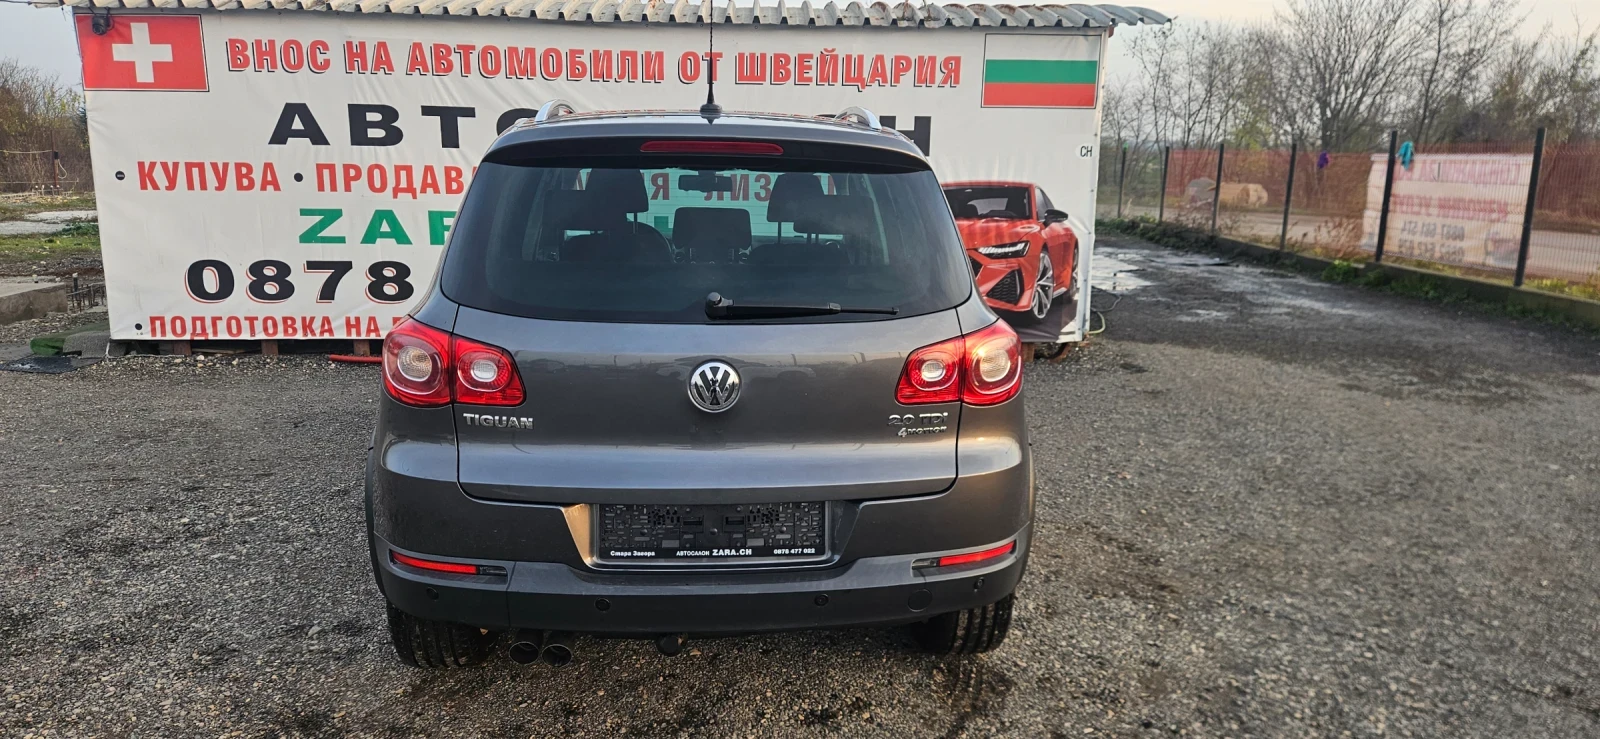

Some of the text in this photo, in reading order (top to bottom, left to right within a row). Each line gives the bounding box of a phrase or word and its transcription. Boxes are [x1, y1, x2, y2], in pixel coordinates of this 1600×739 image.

[226, 38, 962, 92] ВНОС НА АВТОМОБИЛИ ОТ ШВЕЙЦАРИЯ
[1079, 146, 1093, 157] CH
[137, 161, 281, 192] КУПУВА
[315, 163, 478, 200] ПРОДАВ
[185, 259, 414, 303] 0878
[149, 315, 335, 340] ПОДГОТОВКА
[345, 316, 381, 338] НА
[463, 413, 533, 429] TIGUAN
[712, 548, 752, 556] ZARA.CH
